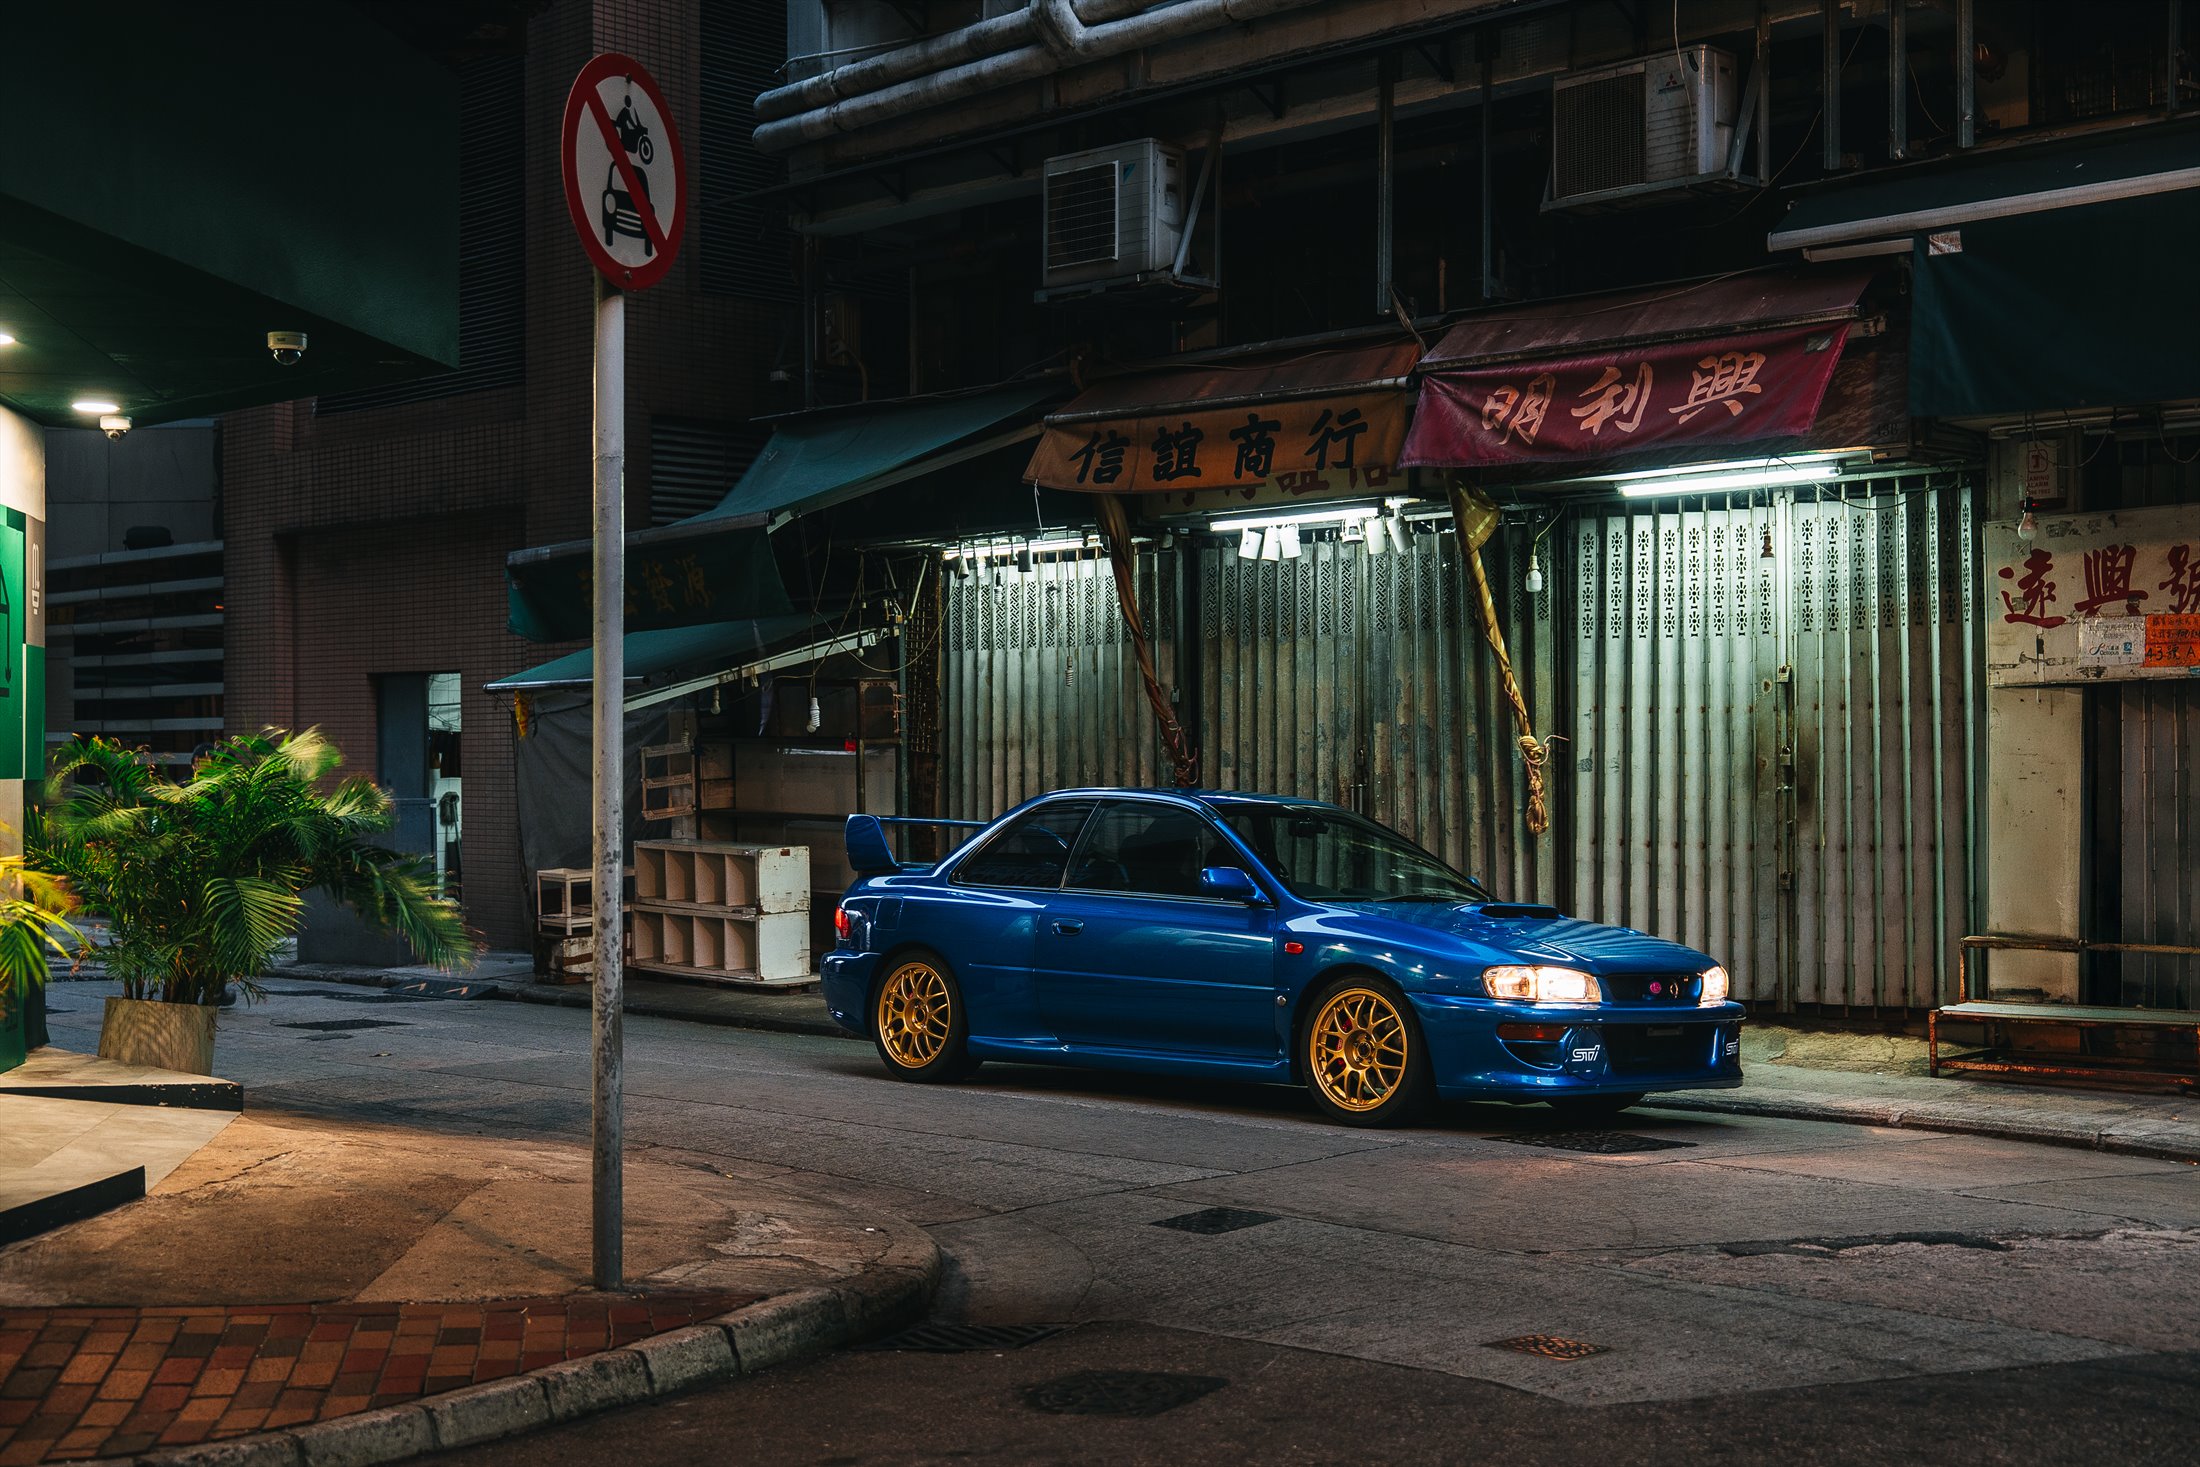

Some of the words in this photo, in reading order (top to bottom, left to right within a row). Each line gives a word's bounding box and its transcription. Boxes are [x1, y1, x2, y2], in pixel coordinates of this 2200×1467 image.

[1481, 351, 1766, 445] 明利興
[1069, 408, 1368, 484] 信誼商行
